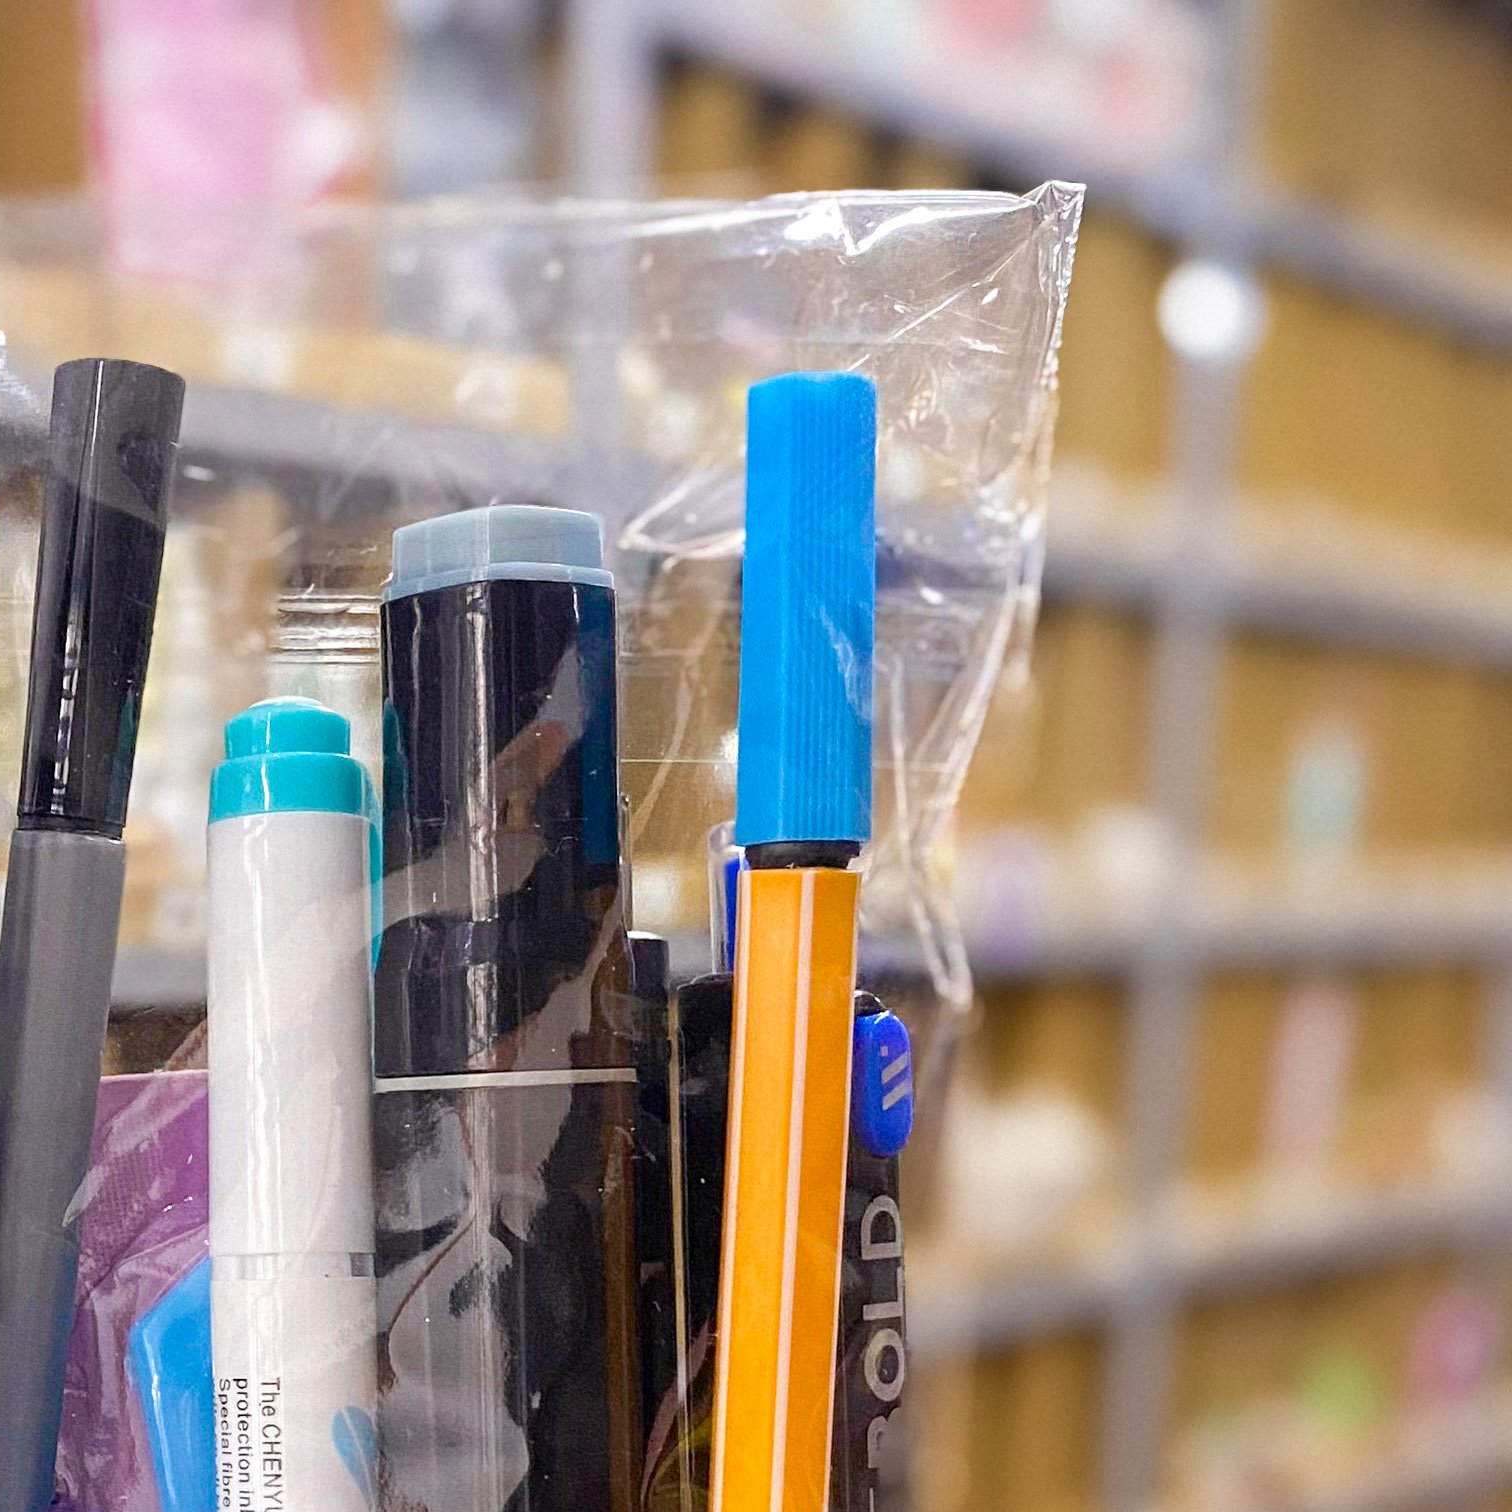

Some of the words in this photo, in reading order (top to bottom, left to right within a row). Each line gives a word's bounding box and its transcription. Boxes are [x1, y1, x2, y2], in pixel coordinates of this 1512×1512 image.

[218, 1378, 233, 1455] Special
[260, 1377, 281, 1417] The
[233, 1377, 255, 1484] protection
[221, 1460, 234, 1508] fibre
